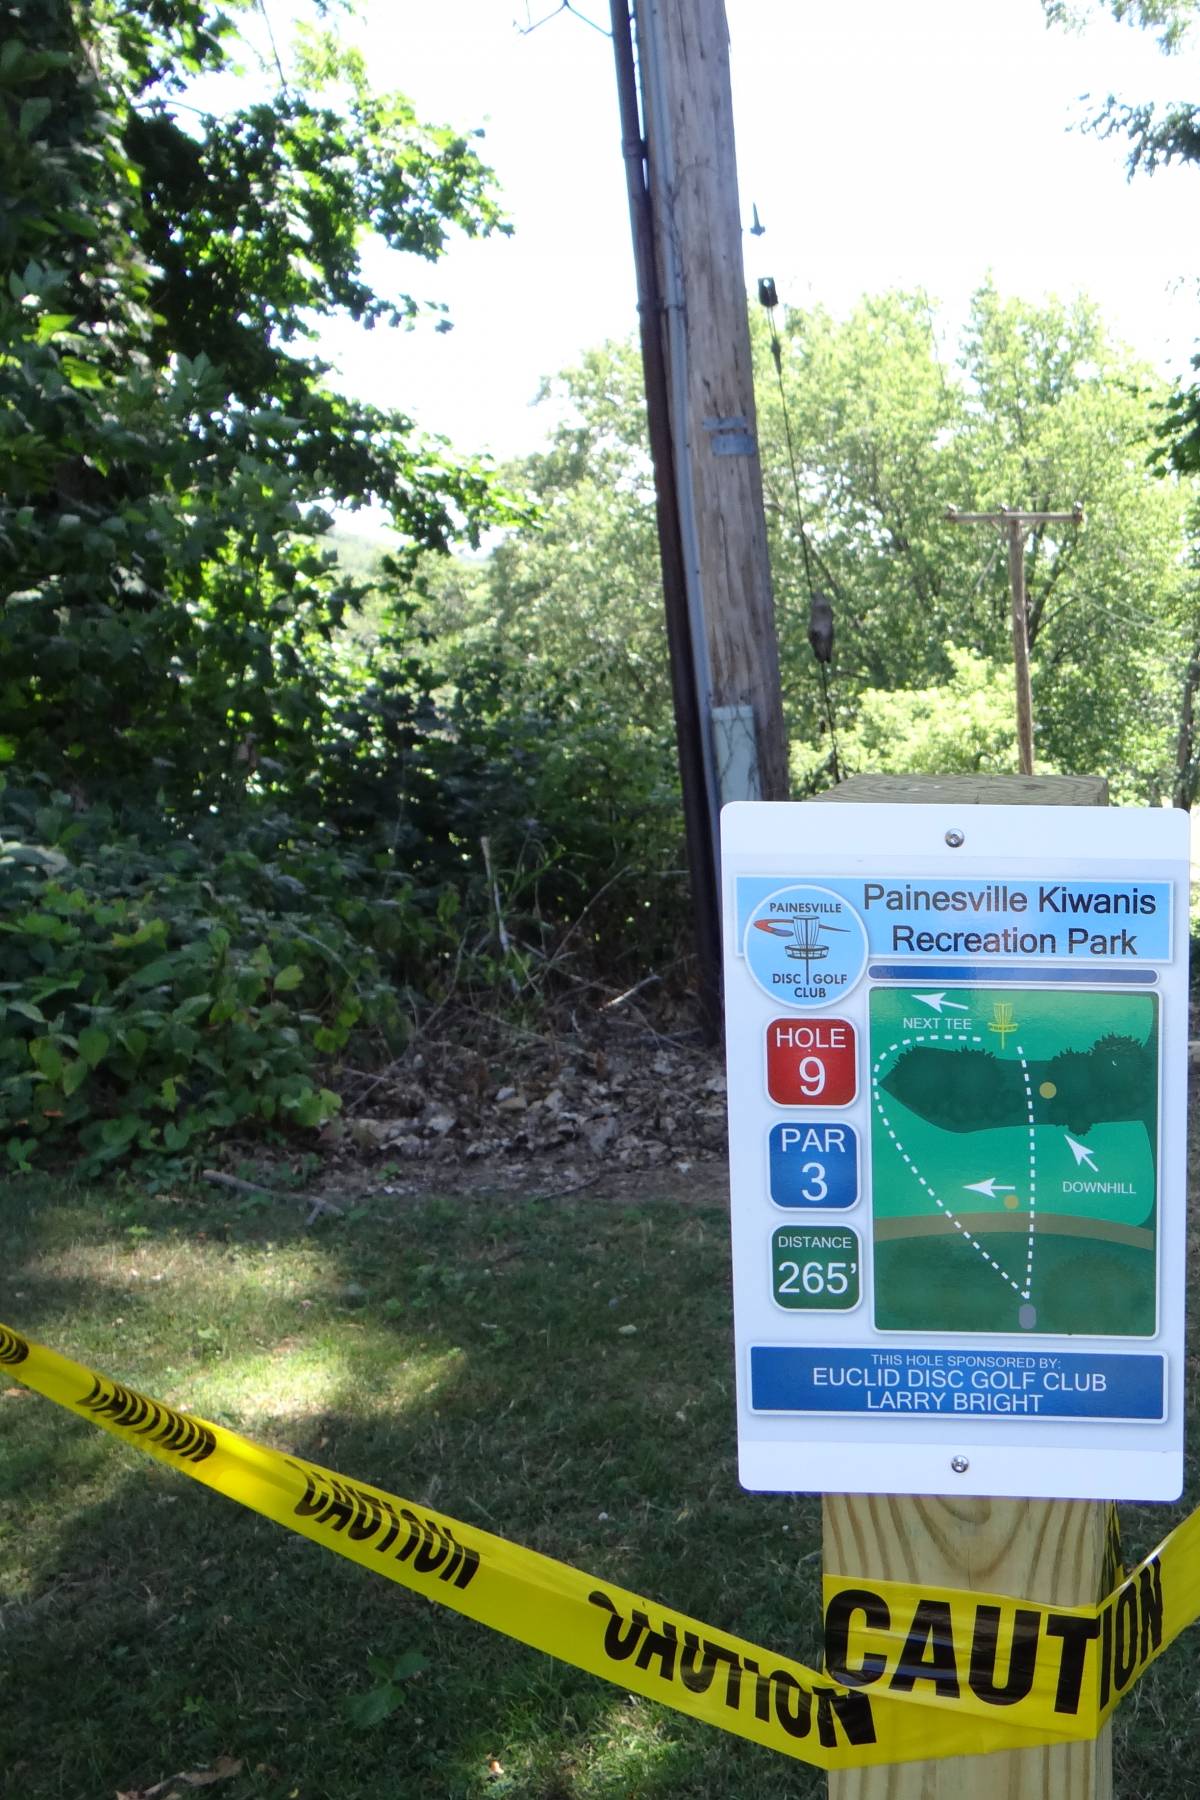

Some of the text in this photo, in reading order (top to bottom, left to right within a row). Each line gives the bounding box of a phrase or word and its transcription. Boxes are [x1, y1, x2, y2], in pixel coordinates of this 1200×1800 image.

[769, 902, 842, 913] PAINESVILLE
[863, 883, 1157, 915] Painesville Kiwanis
[892, 925, 1138, 956] Recreation Park
[772, 973, 848, 985] DISC GOLF
[794, 987, 827, 999] CLUB
[903, 1017, 972, 1031] NEXT TEE
[776, 1027, 846, 1049] HOLE
[799, 1056, 826, 1097] 9
[781, 1128, 846, 1153] PAR
[801, 1162, 829, 1202] 3
[1062, 1180, 1137, 1195] DOWNHILL
[778, 1235, 852, 1250] DISTANCE
[871, 1354, 1061, 1369] THIS HOLE SPONSORED BY:
[812, 1367, 1107, 1393] EUCLID DISC GOLF CLUB
[867, 1391, 1044, 1413] LARRY BRIGHT
[285, 1459, 480, 1590] CAUTION
[824, 1555, 1163, 1715] CAUTION
[588, 1590, 876, 1748] CAUTION
